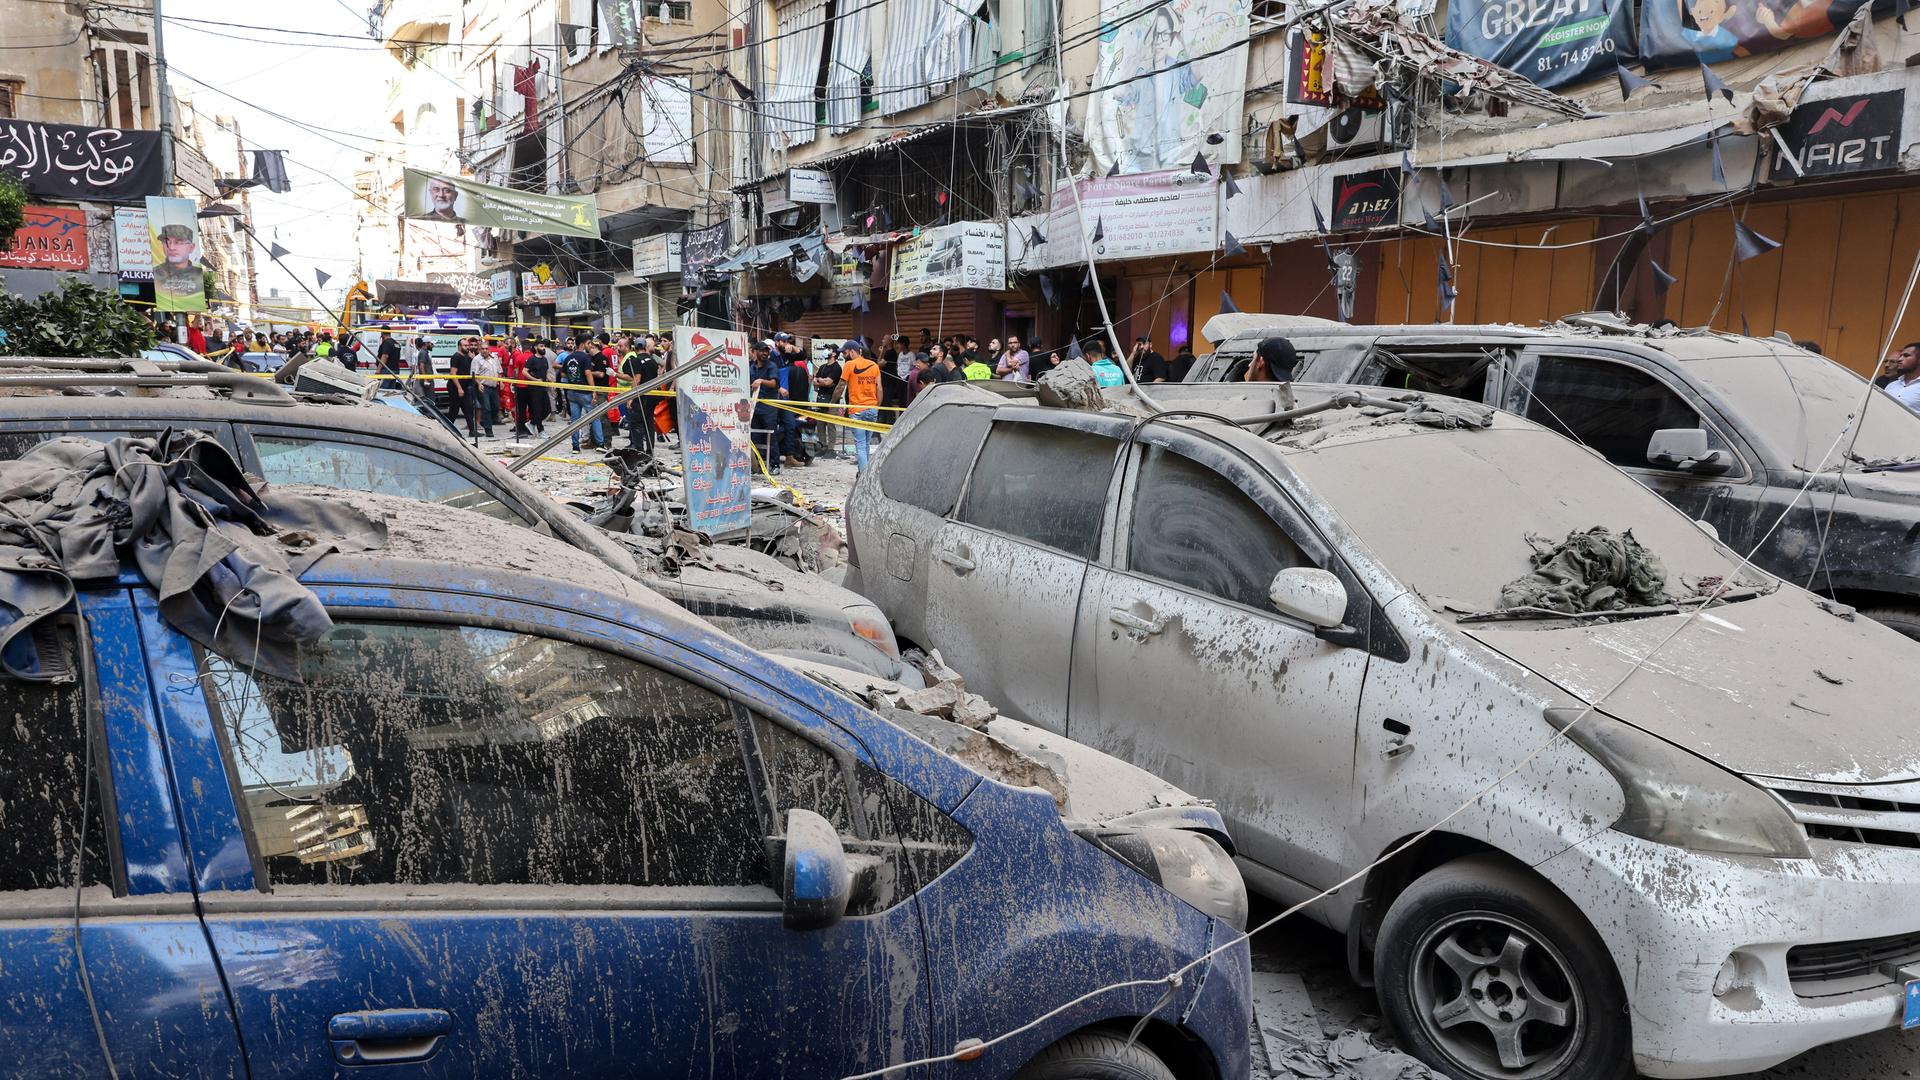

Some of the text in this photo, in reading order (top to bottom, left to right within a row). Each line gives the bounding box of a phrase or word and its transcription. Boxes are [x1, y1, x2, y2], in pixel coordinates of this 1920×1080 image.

[1481, 0, 1589, 40] GREAT
[1545, 19, 1610, 42] REGISTER NOW
[55, 129, 134, 186] موكب
[10, 235, 76, 252] HANSA
[122, 270, 155, 280] ALKHA
[701, 364, 737, 378] SLEEM
